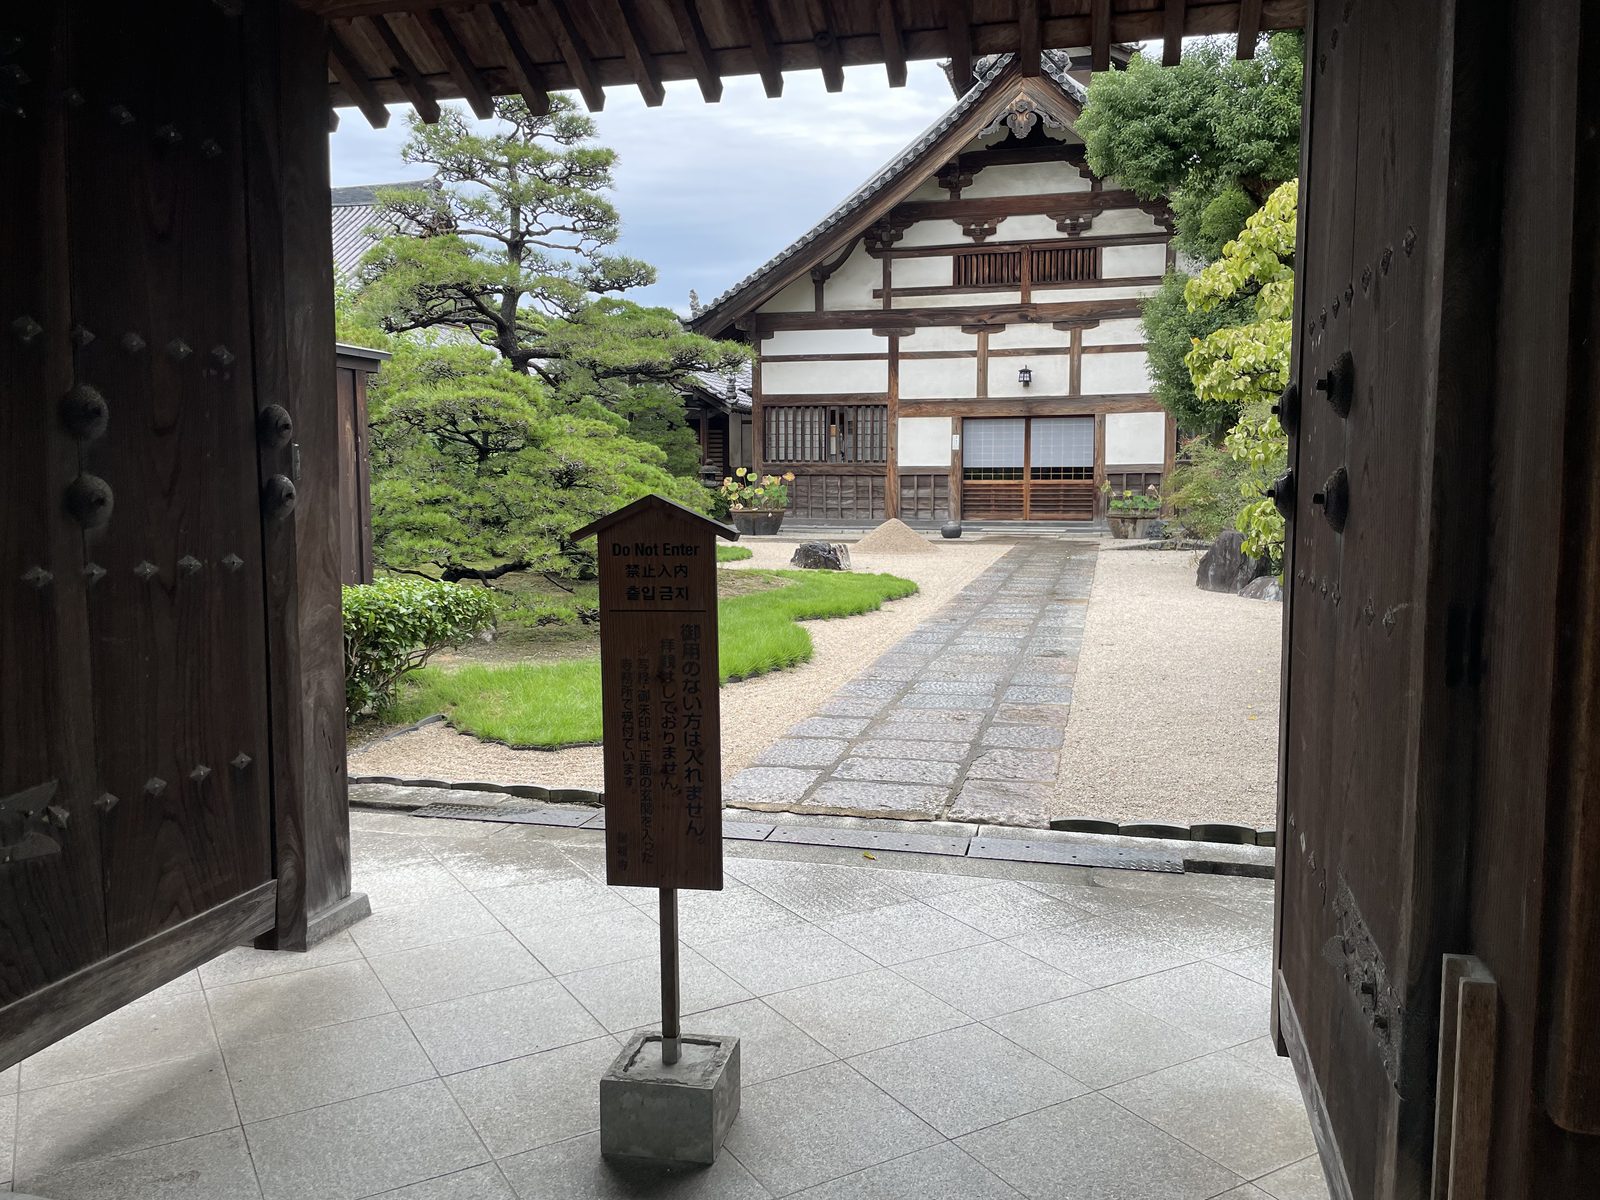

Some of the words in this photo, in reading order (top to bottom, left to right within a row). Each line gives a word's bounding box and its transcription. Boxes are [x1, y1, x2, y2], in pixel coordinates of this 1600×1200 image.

[612, 543, 630, 556] Do
[635, 543, 659, 556] Not
[663, 543, 700, 556] Enter
[625, 563, 688, 578] 禁止入内
[625, 585, 689, 601] 출입금지
[680, 623, 706, 845] 御用のない方は入れません。
